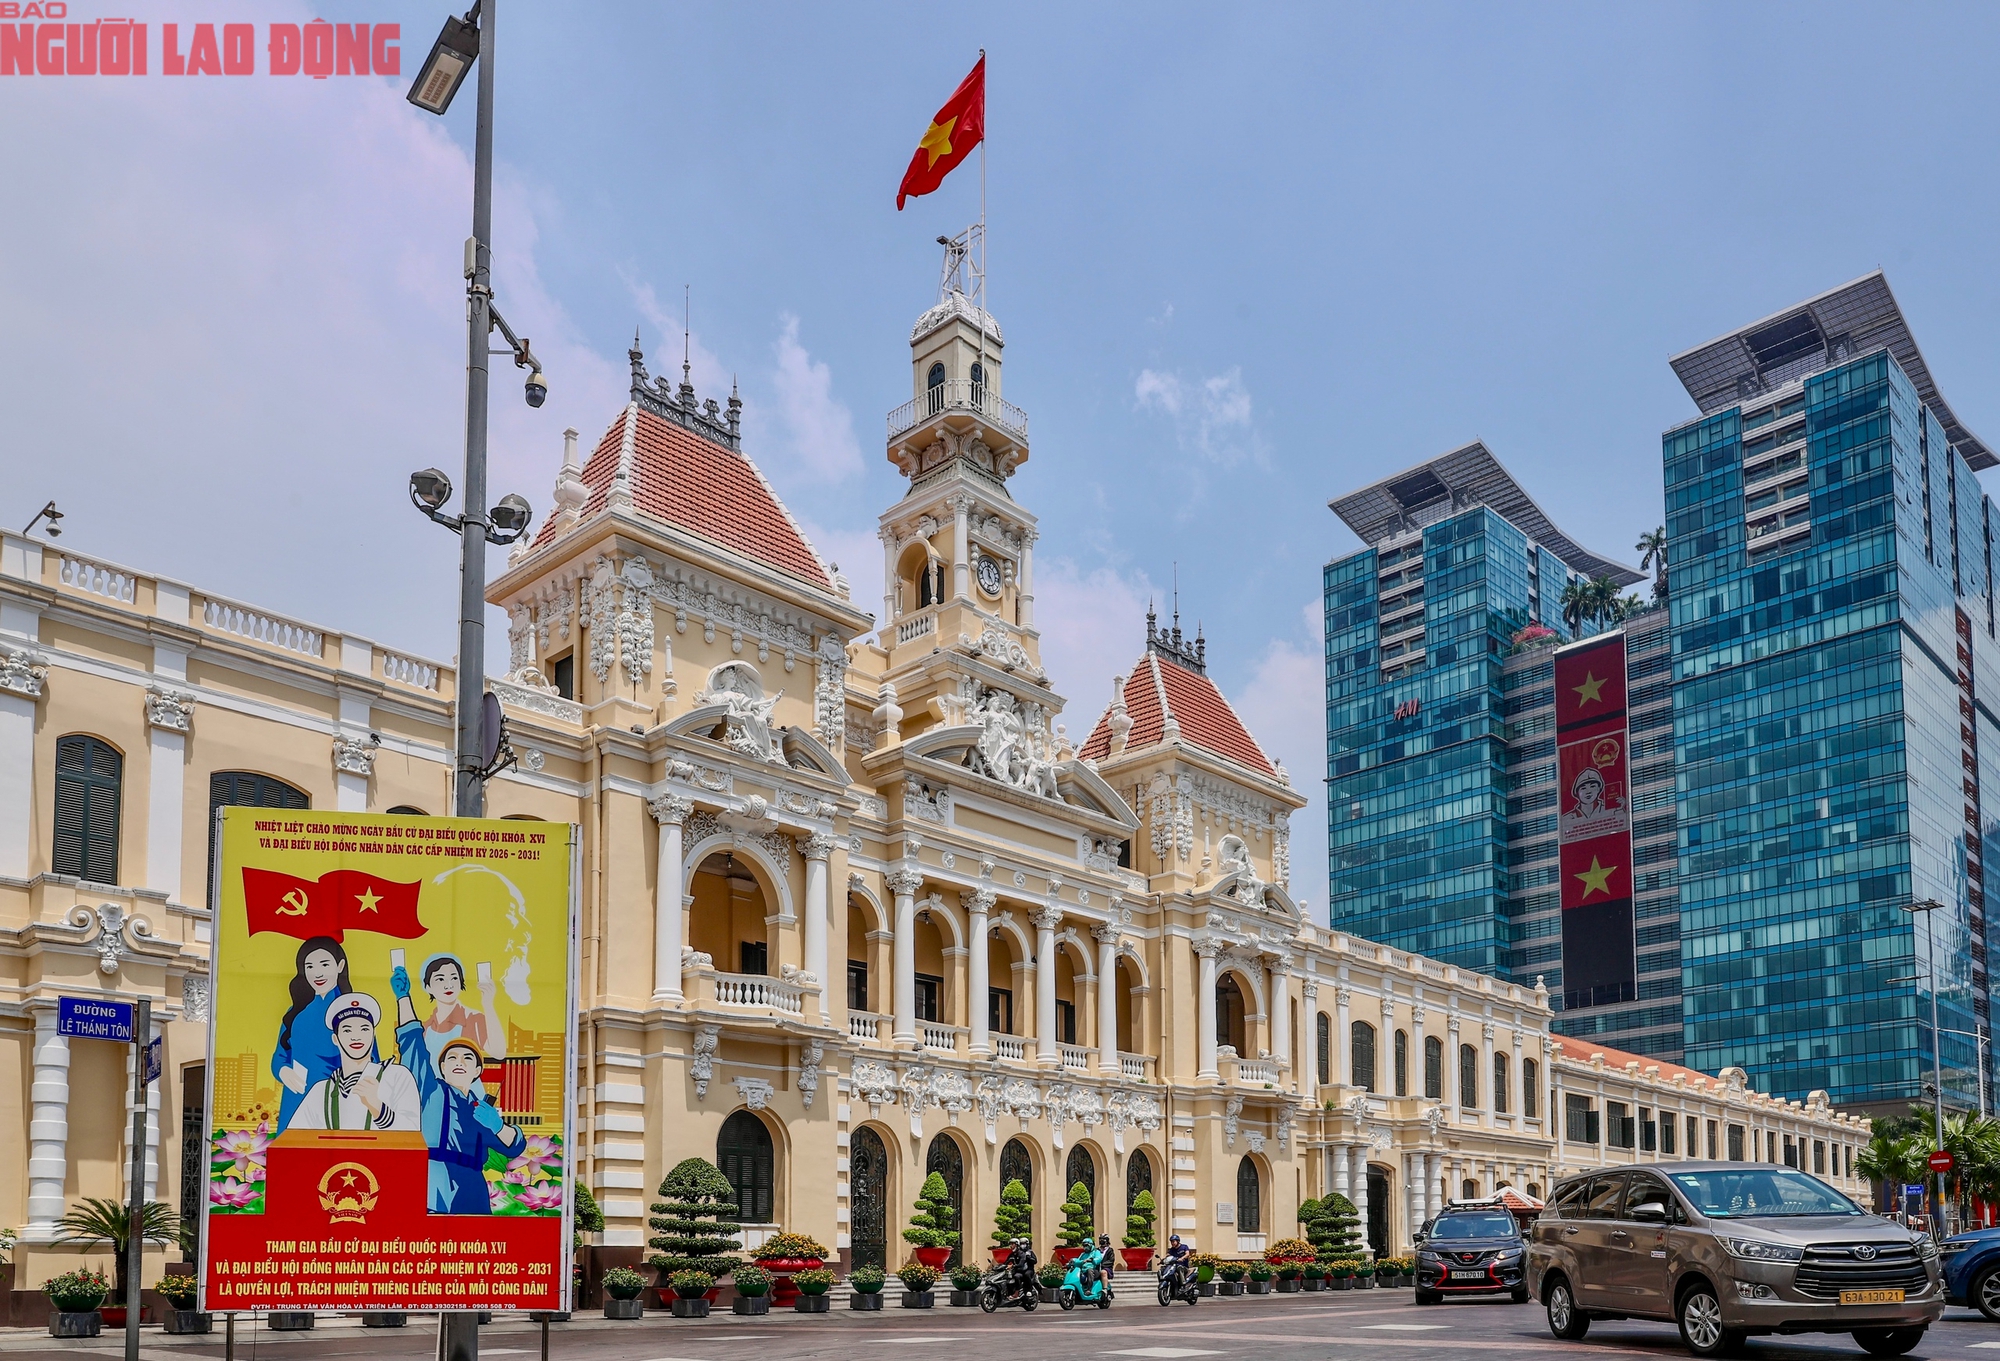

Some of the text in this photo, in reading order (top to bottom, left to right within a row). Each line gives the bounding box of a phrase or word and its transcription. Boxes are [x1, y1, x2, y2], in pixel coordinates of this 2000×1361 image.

[255, 820, 282, 834] NHIỆT
[284, 821, 304, 835] LIỆT
[306, 822, 330, 834] CHÀO
[333, 823, 358, 835] MỪNG
[361, 825, 384, 836] NGÀY
[405, 826, 417, 838] CỬ
[419, 829, 434, 841] ĐẠI
[436, 826, 456, 840] BIỂU
[458, 828, 481, 842] QUỐC
[484, 830, 499, 844] HỘI
[502, 831, 525, 843] KHÓA
[530, 834, 545, 844] XVI
[260, 836, 271, 848] VÀ
[273, 839, 288, 851] ĐẠI
[291, 837, 311, 850] BIỂU
[314, 839, 330, 853] HỘI
[359, 841, 383, 853] NHÂN
[386, 842, 404, 854] DÂN
[406, 843, 423, 855] CÁC
[425, 843, 442, 856] CẤP
[445, 845, 473, 859] NHIỆM
[476, 846, 487, 858] KỲ
[489, 848, 508, 859] 2026
[73, 1002, 116, 1018] ĐƯỜNG
[60, 1018, 130, 1038] LÊ THÁNH TÔN
[266, 1241, 296, 1253] THAM
[299, 1241, 316, 1253] GIA
[345, 1237, 360, 1253] CỬ
[362, 1241, 379, 1256] ĐẠI
[382, 1237, 406, 1253] BIỂU
[409, 1238, 436, 1255] QUỐC
[440, 1239, 457, 1256] HỘI
[460, 1240, 487, 1254] KHÓA
[491, 1242, 506, 1254] XVI
[216, 1259, 229, 1274] VÀ
[233, 1262, 251, 1276] ĐẠI
[254, 1258, 278, 1274] BIỂU
[282, 1259, 299, 1276] HỘI
[335, 1260, 364, 1274] NHÂN
[368, 1260, 389, 1274] DÂN
[393, 1260, 413, 1274] CÁC
[417, 1258, 437, 1274] CẤP
[441, 1260, 474, 1277] NHIỆM
[477, 1260, 490, 1274] KỲ
[493, 1263, 518, 1274] 2026
[528, 1263, 551, 1274] 2031
[220, 1281, 232, 1295] LÀ
[274, 1282, 293, 1297] LỢI,
[297, 1280, 331, 1295] TRÁCH
[334, 1280, 369, 1297] NHIỆM
[372, 1280, 409, 1295] THIÊNG
[412, 1280, 442, 1295] LIÊNG
[445, 1280, 466, 1295] CỦA
[469, 1280, 488, 1295] MỖI
[492, 1281, 520, 1295] CÔNG
[523, 1281, 547, 1295] DÂN!
[1845, 1291, 1899, 1302] 63A-130.21
